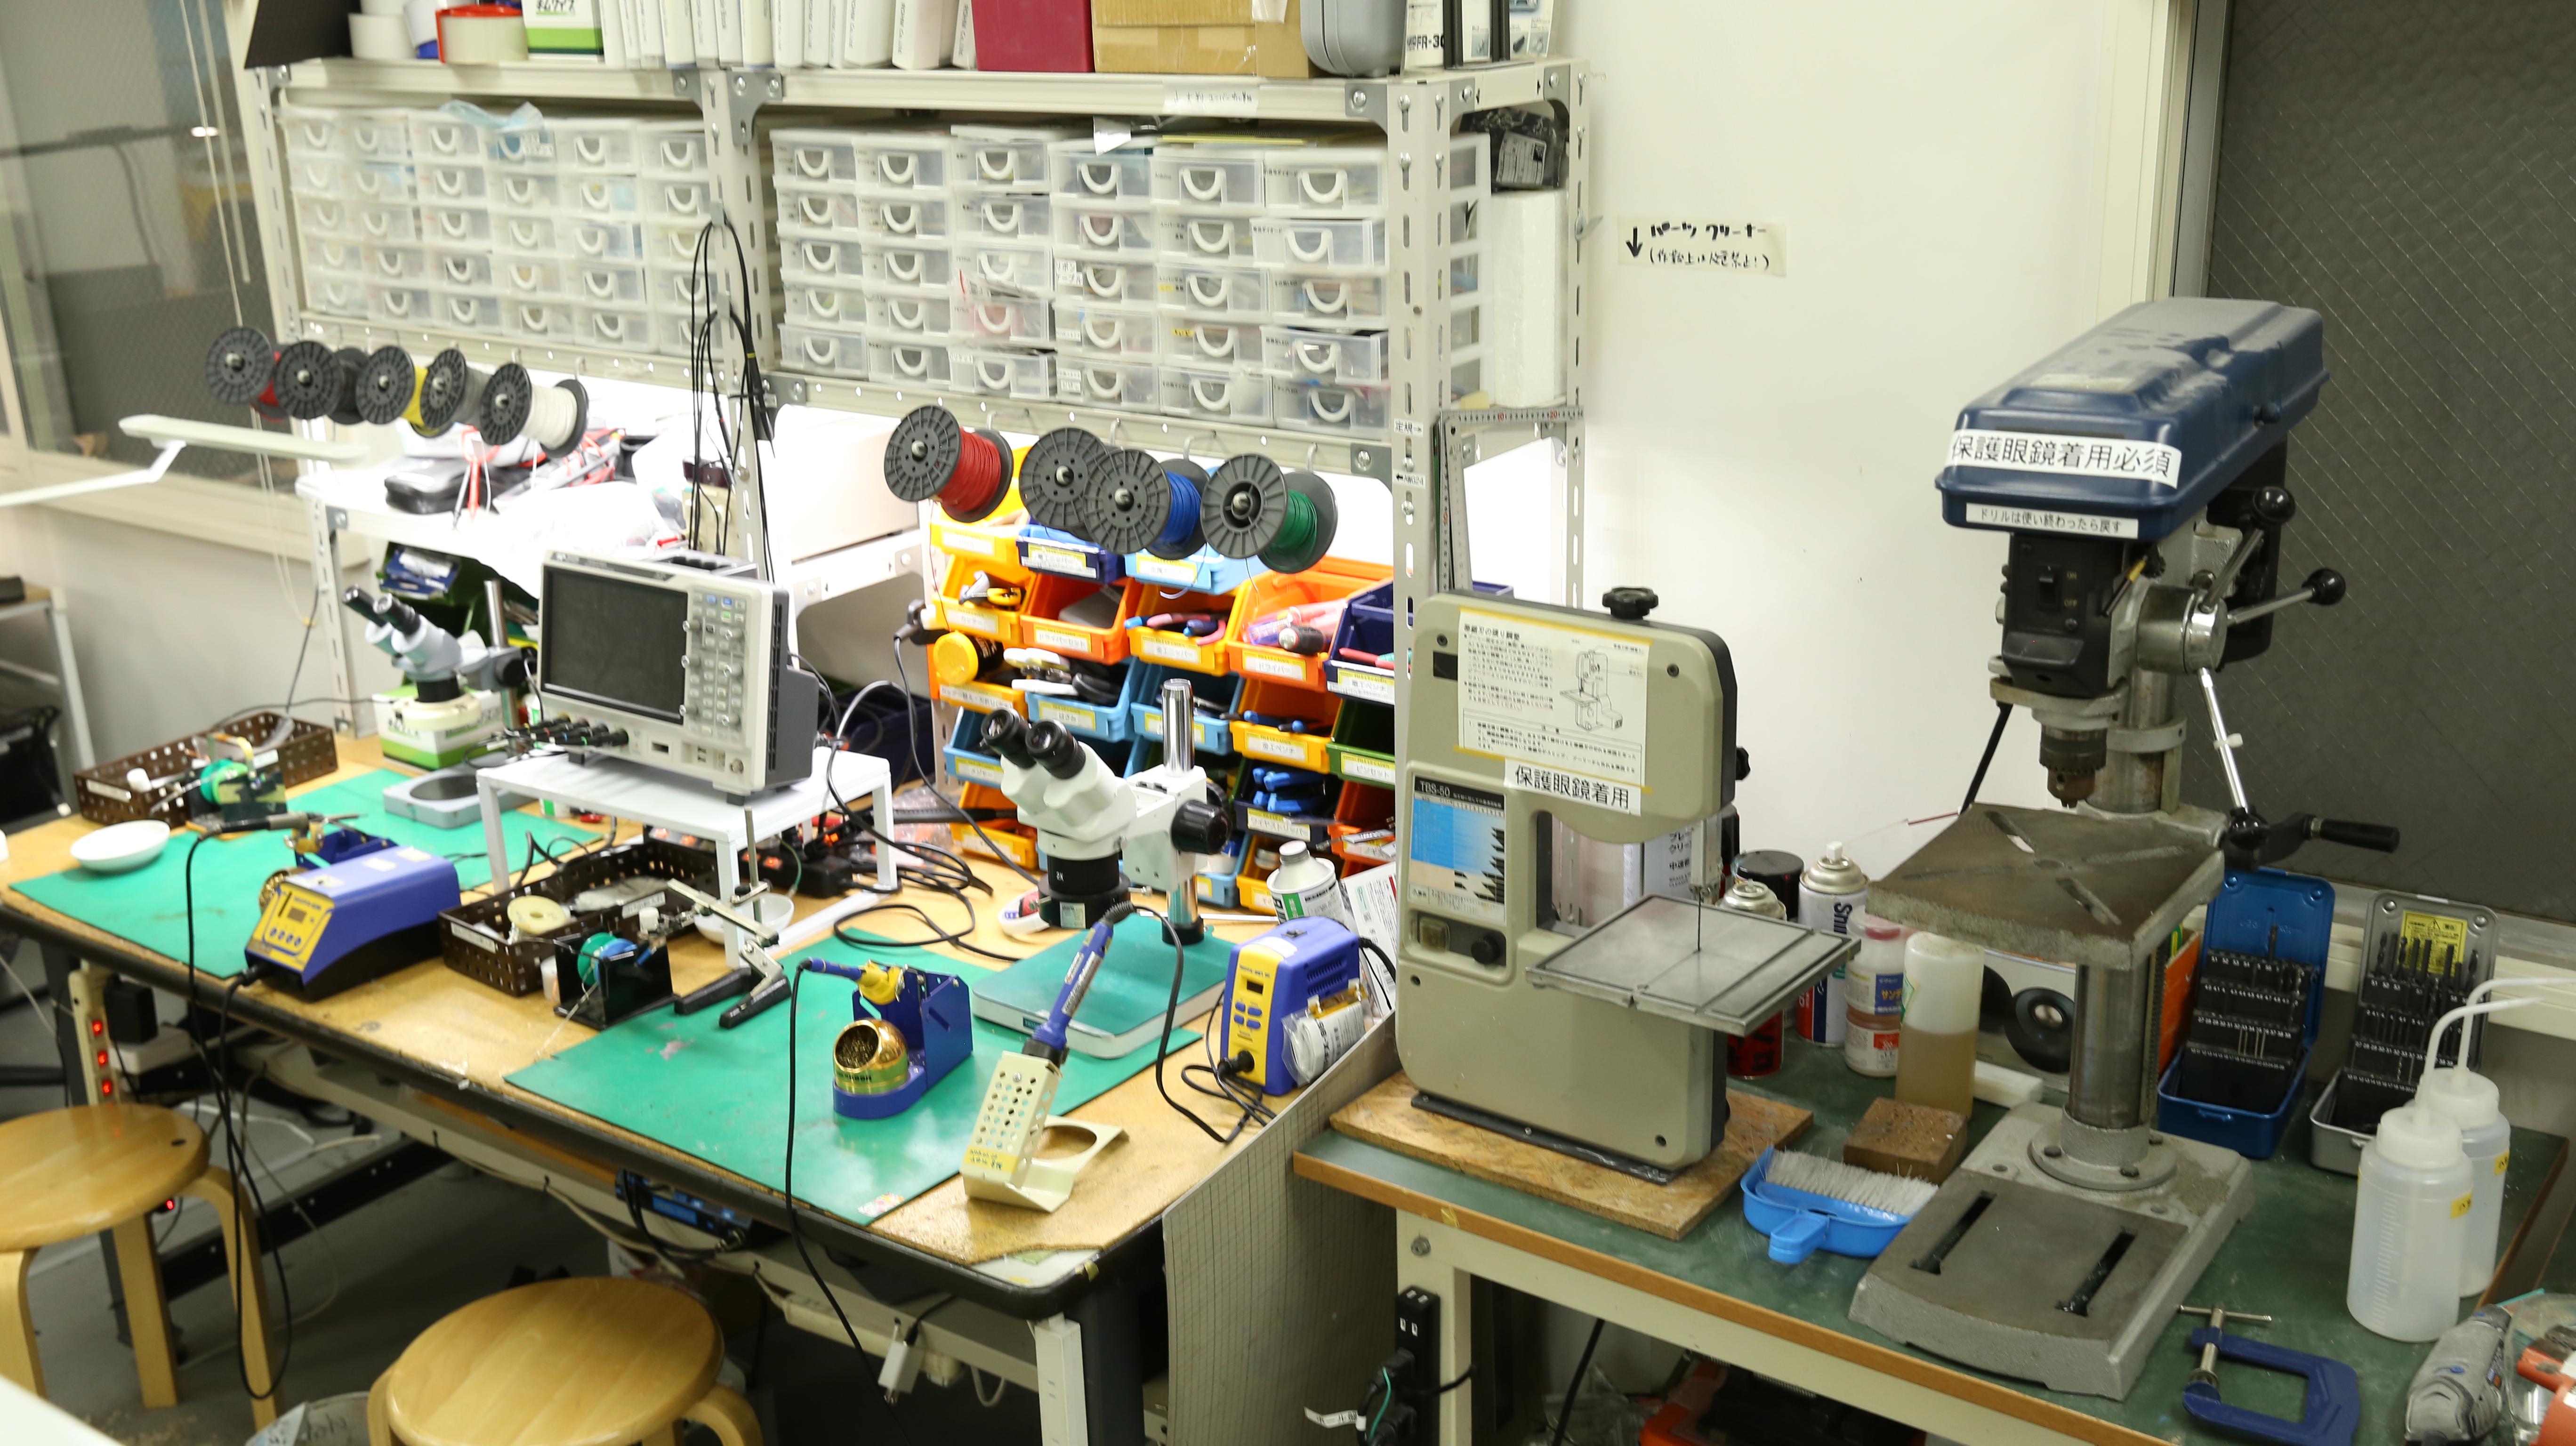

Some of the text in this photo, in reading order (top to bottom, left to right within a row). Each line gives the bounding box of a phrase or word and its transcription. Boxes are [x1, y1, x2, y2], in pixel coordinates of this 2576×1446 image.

[1650, 221, 1767, 241] パーツ クリーナー
[1952, 434, 2173, 478] 保護眼鏡着用必須
[1980, 507, 2121, 534] ドリルは使い終わったら戻す
[1420, 780, 1451, 798] TBS-50
[1515, 764, 1629, 810] 保護眼鏡着用
